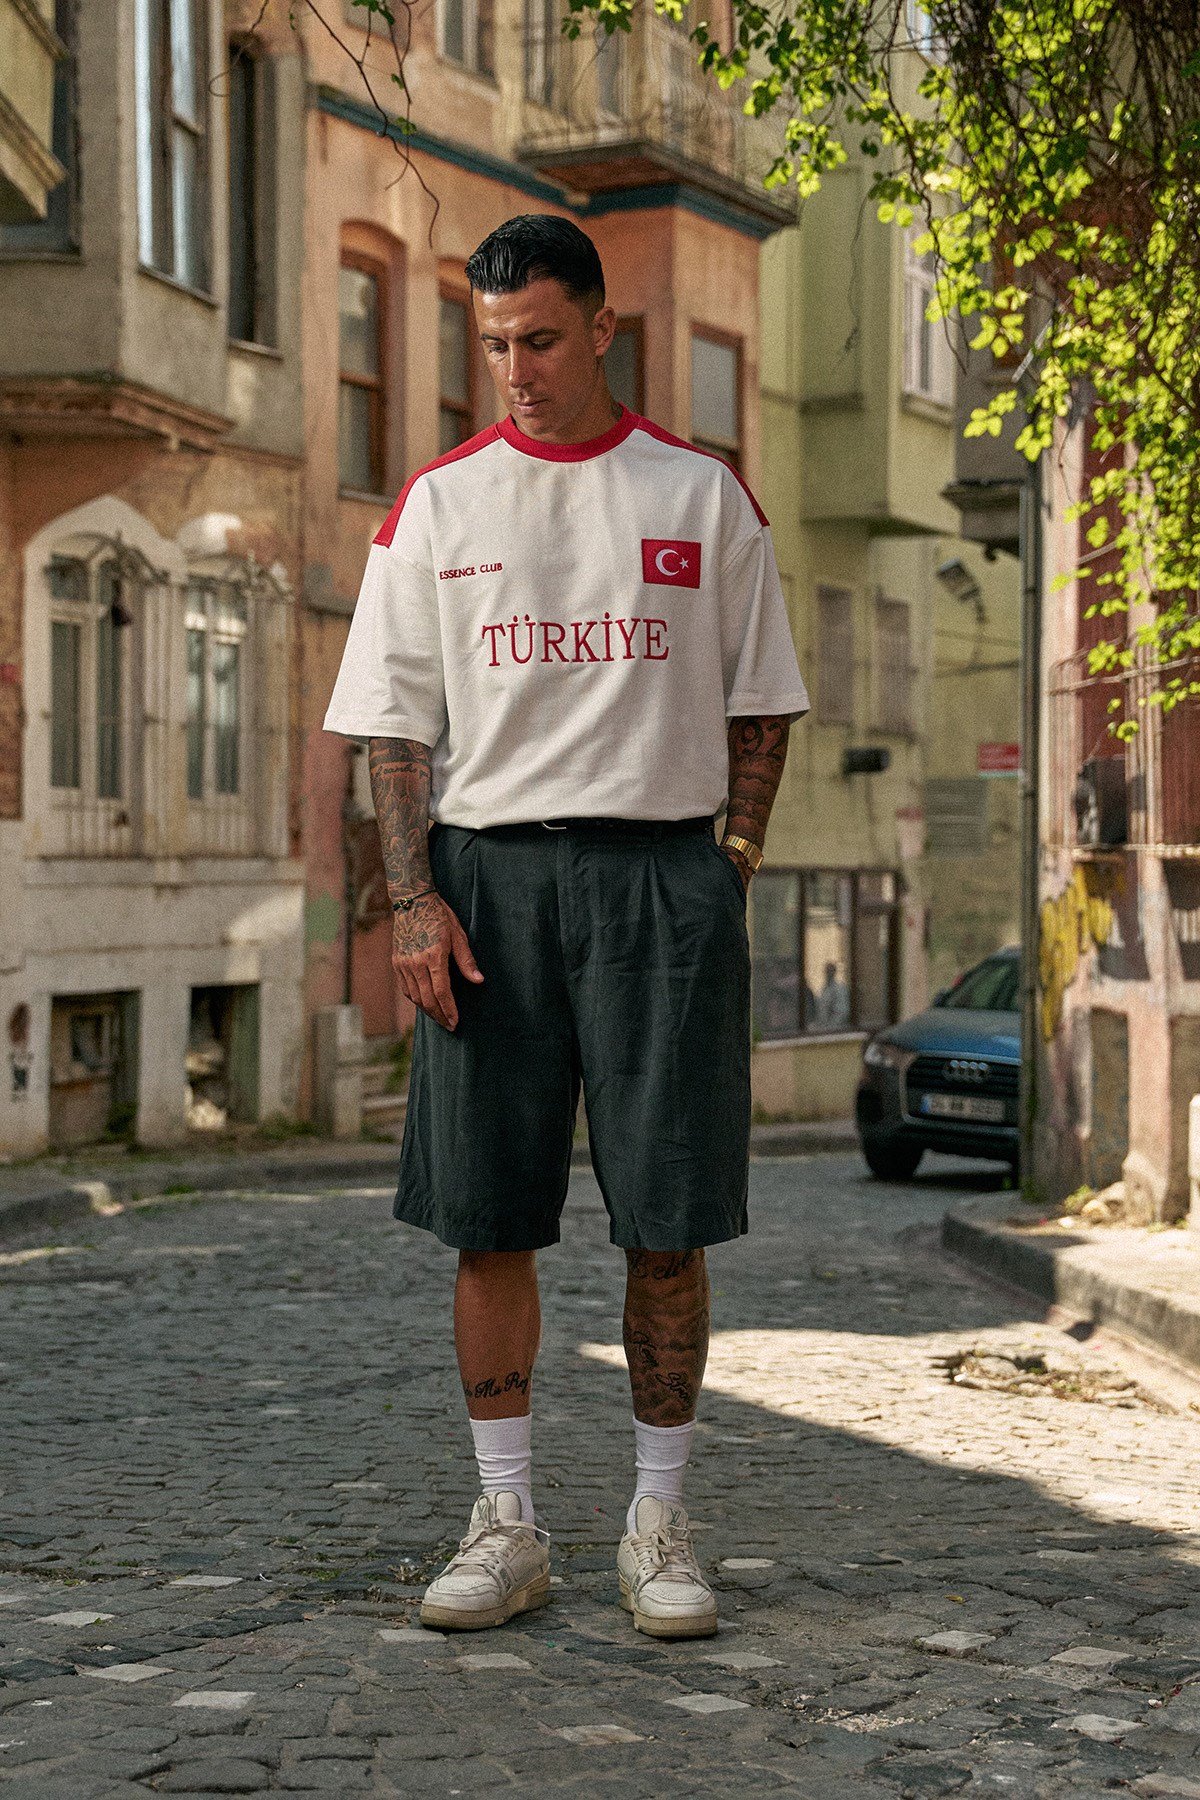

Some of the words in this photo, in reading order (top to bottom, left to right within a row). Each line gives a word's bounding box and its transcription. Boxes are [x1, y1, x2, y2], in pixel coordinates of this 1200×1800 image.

[439, 566, 476, 580] ESSENCE
[480, 562, 503, 573] CLUB
[482, 612, 669, 666] TÜRKİYE
